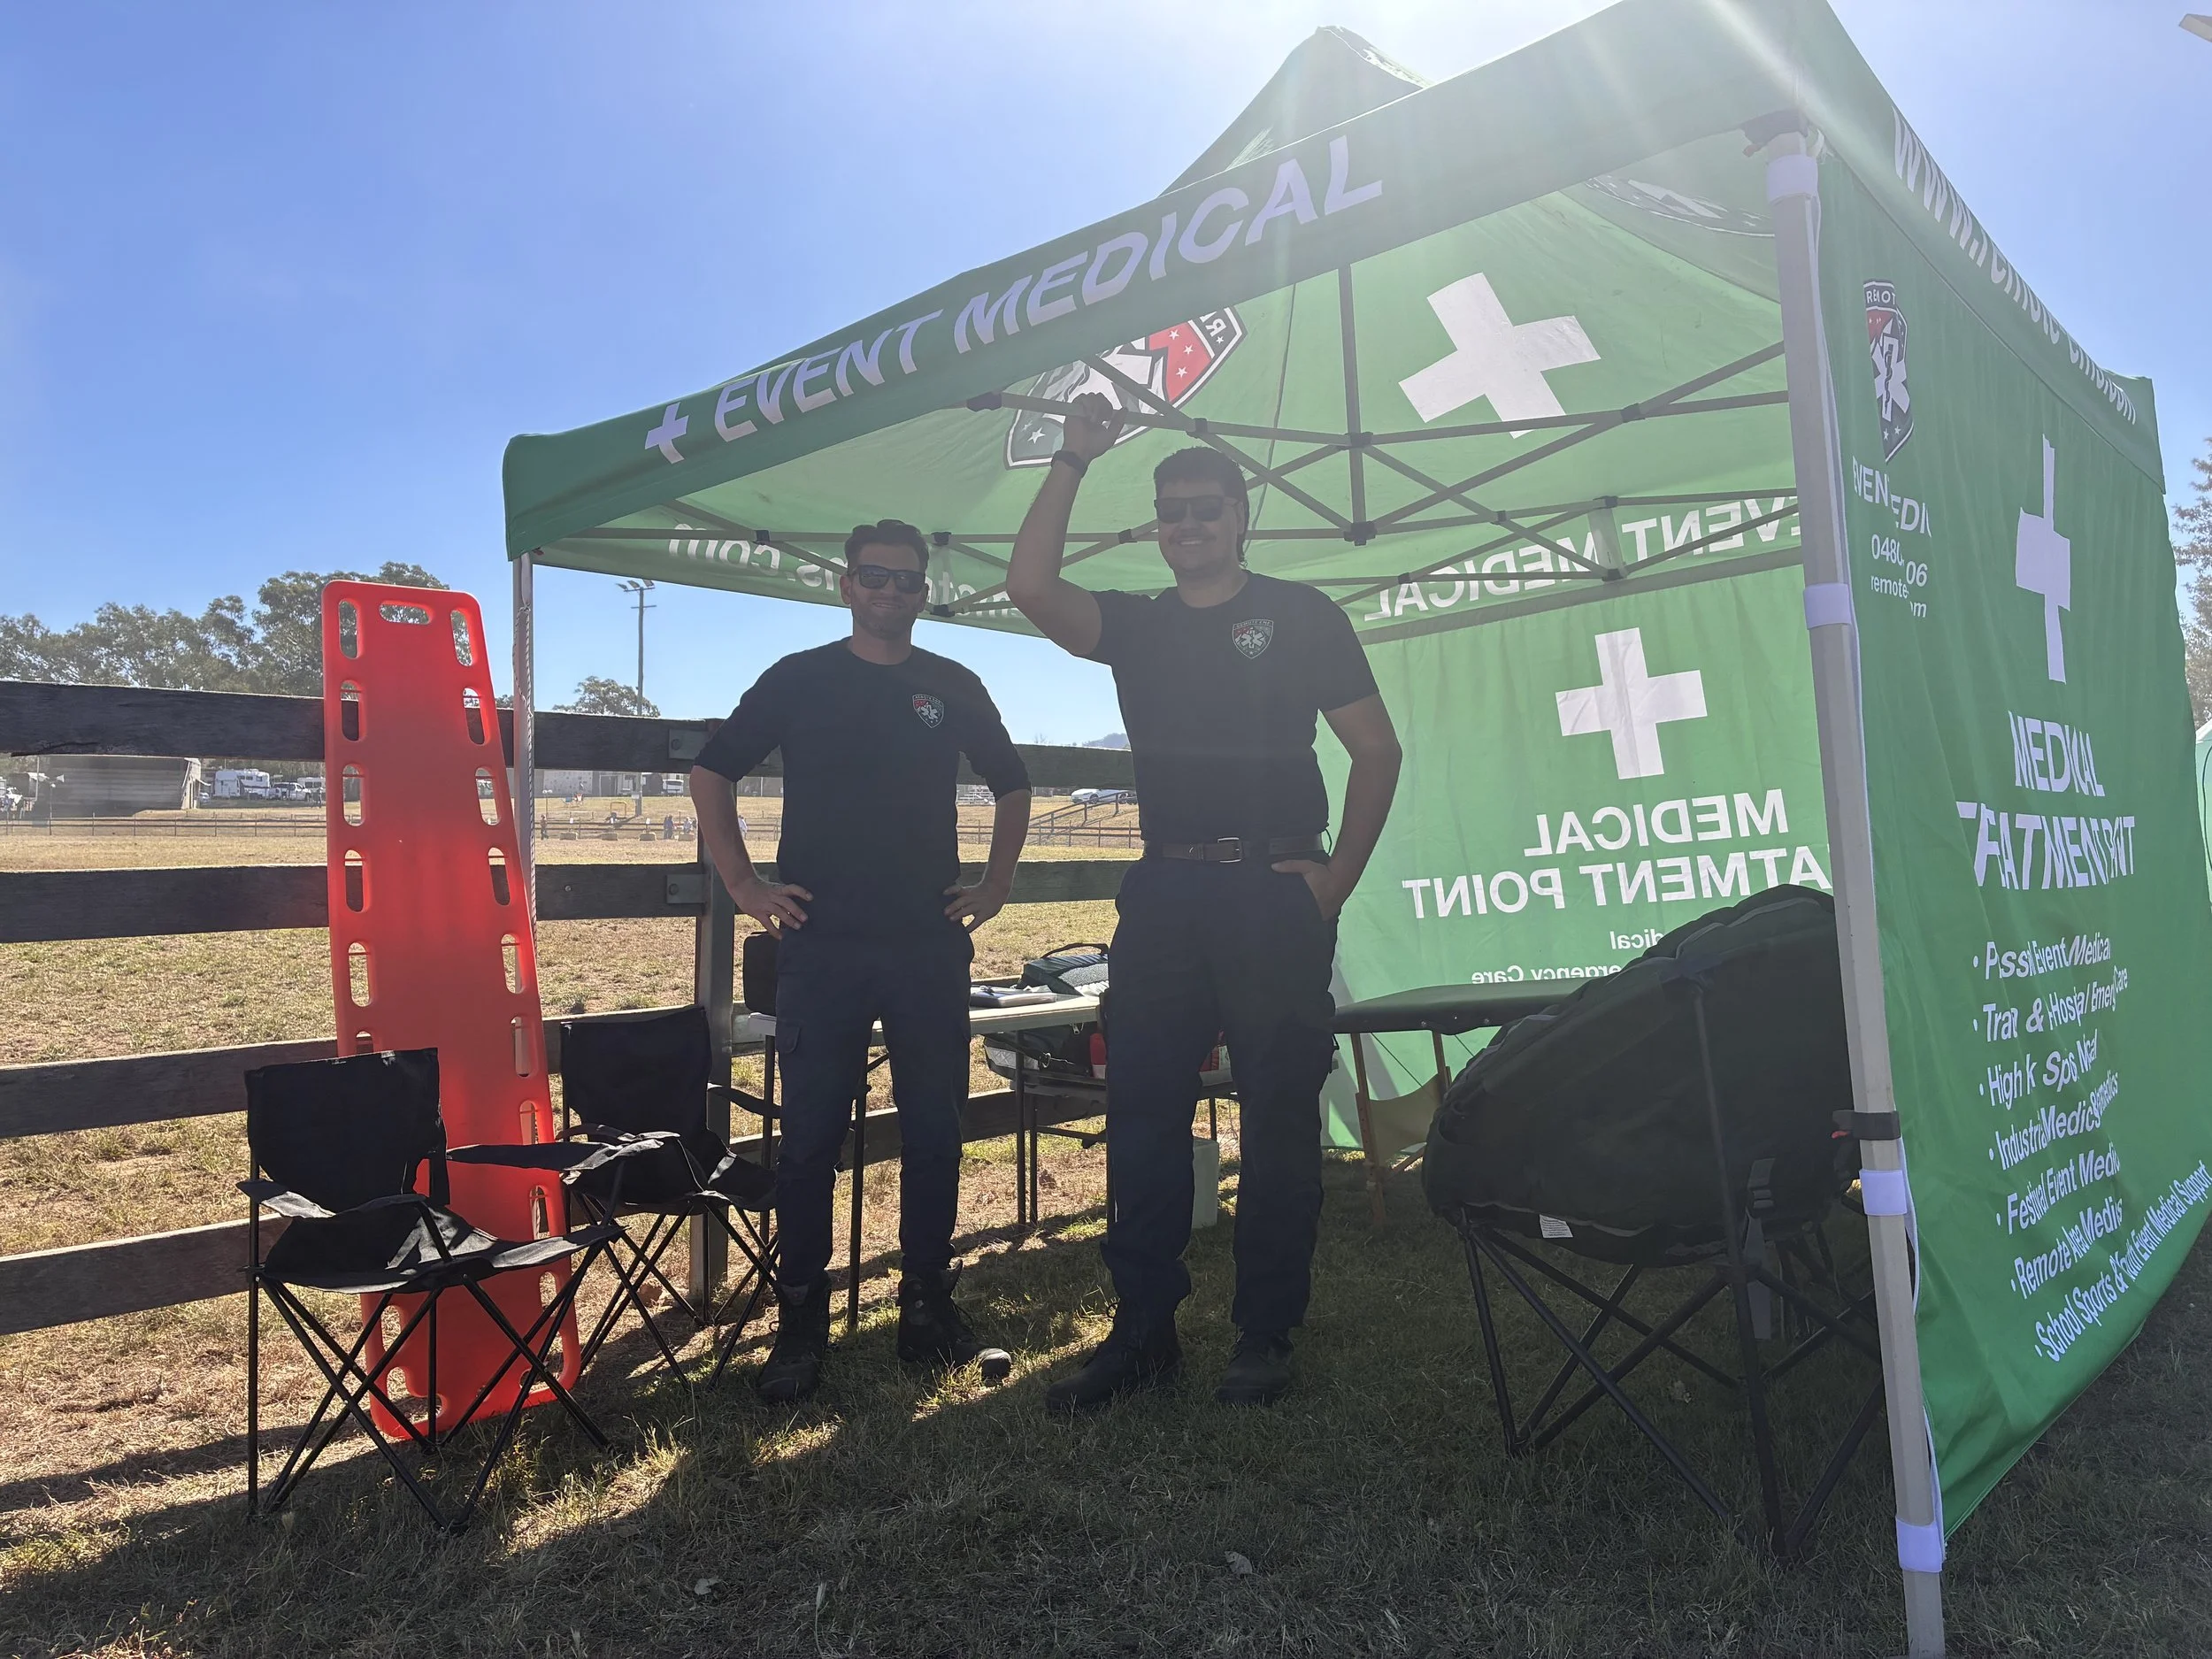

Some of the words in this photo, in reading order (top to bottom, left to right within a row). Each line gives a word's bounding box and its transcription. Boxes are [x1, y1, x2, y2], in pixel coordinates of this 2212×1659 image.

[714, 309, 943, 442] EVENT
[953, 134, 1383, 354] MEDICAL
[2025, 997, 2044, 1033] &
[1987, 1062, 2023, 1110] High
[2007, 1172, 2049, 1235] Festival
[2047, 1159, 2078, 1206] Event
[2173, 1159, 2212, 1203] Support
[2131, 1217, 2162, 1261] Event
[2146, 1186, 2189, 1238] Medical
[2014, 1238, 2072, 1300] Remote
[2071, 1271, 2117, 1327] Sports
[2035, 1294, 2086, 1363] School
